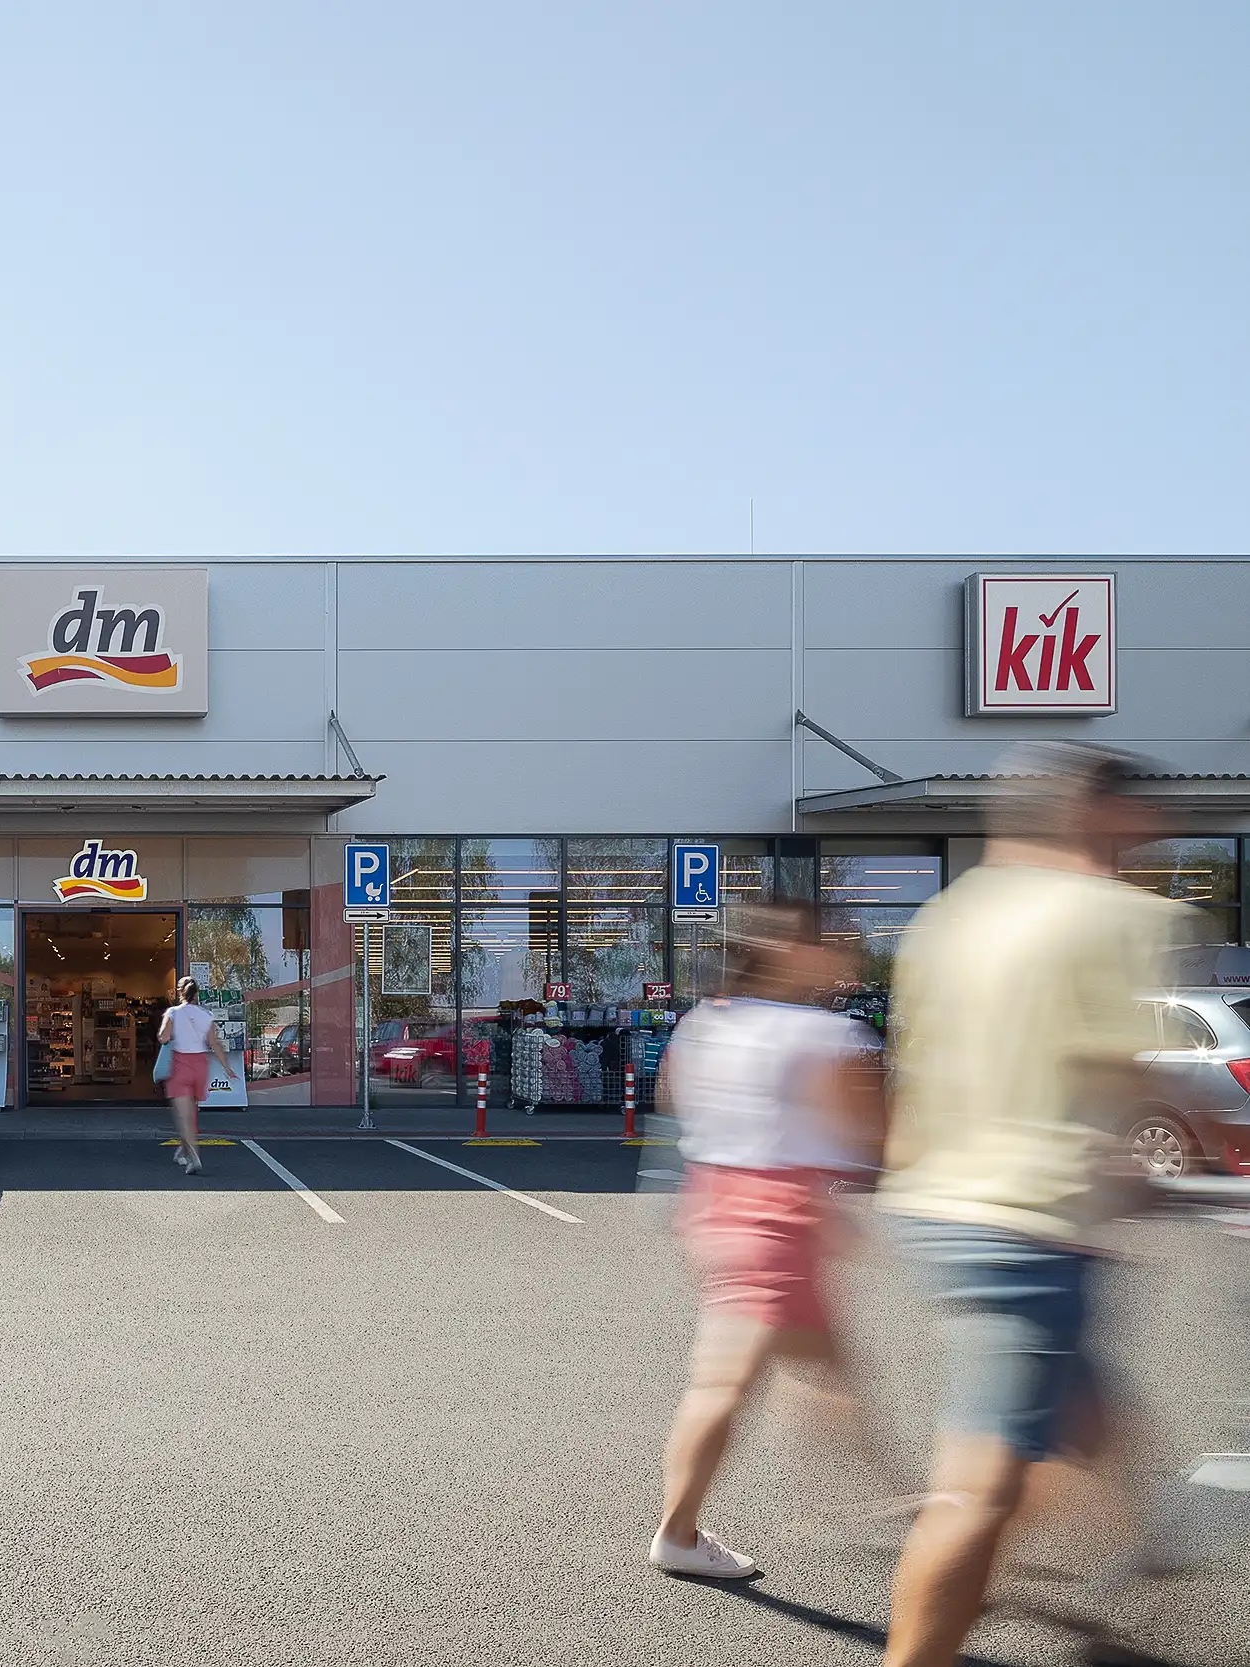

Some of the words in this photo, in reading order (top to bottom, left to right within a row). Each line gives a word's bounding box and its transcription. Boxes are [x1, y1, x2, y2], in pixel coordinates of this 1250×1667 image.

[52, 590, 161, 654] dm
[994, 589, 1102, 691] kik
[73, 842, 134, 878] dm
[354, 851, 380, 888] P
[683, 852, 710, 888] P
[210, 1078, 229, 1088] dm
